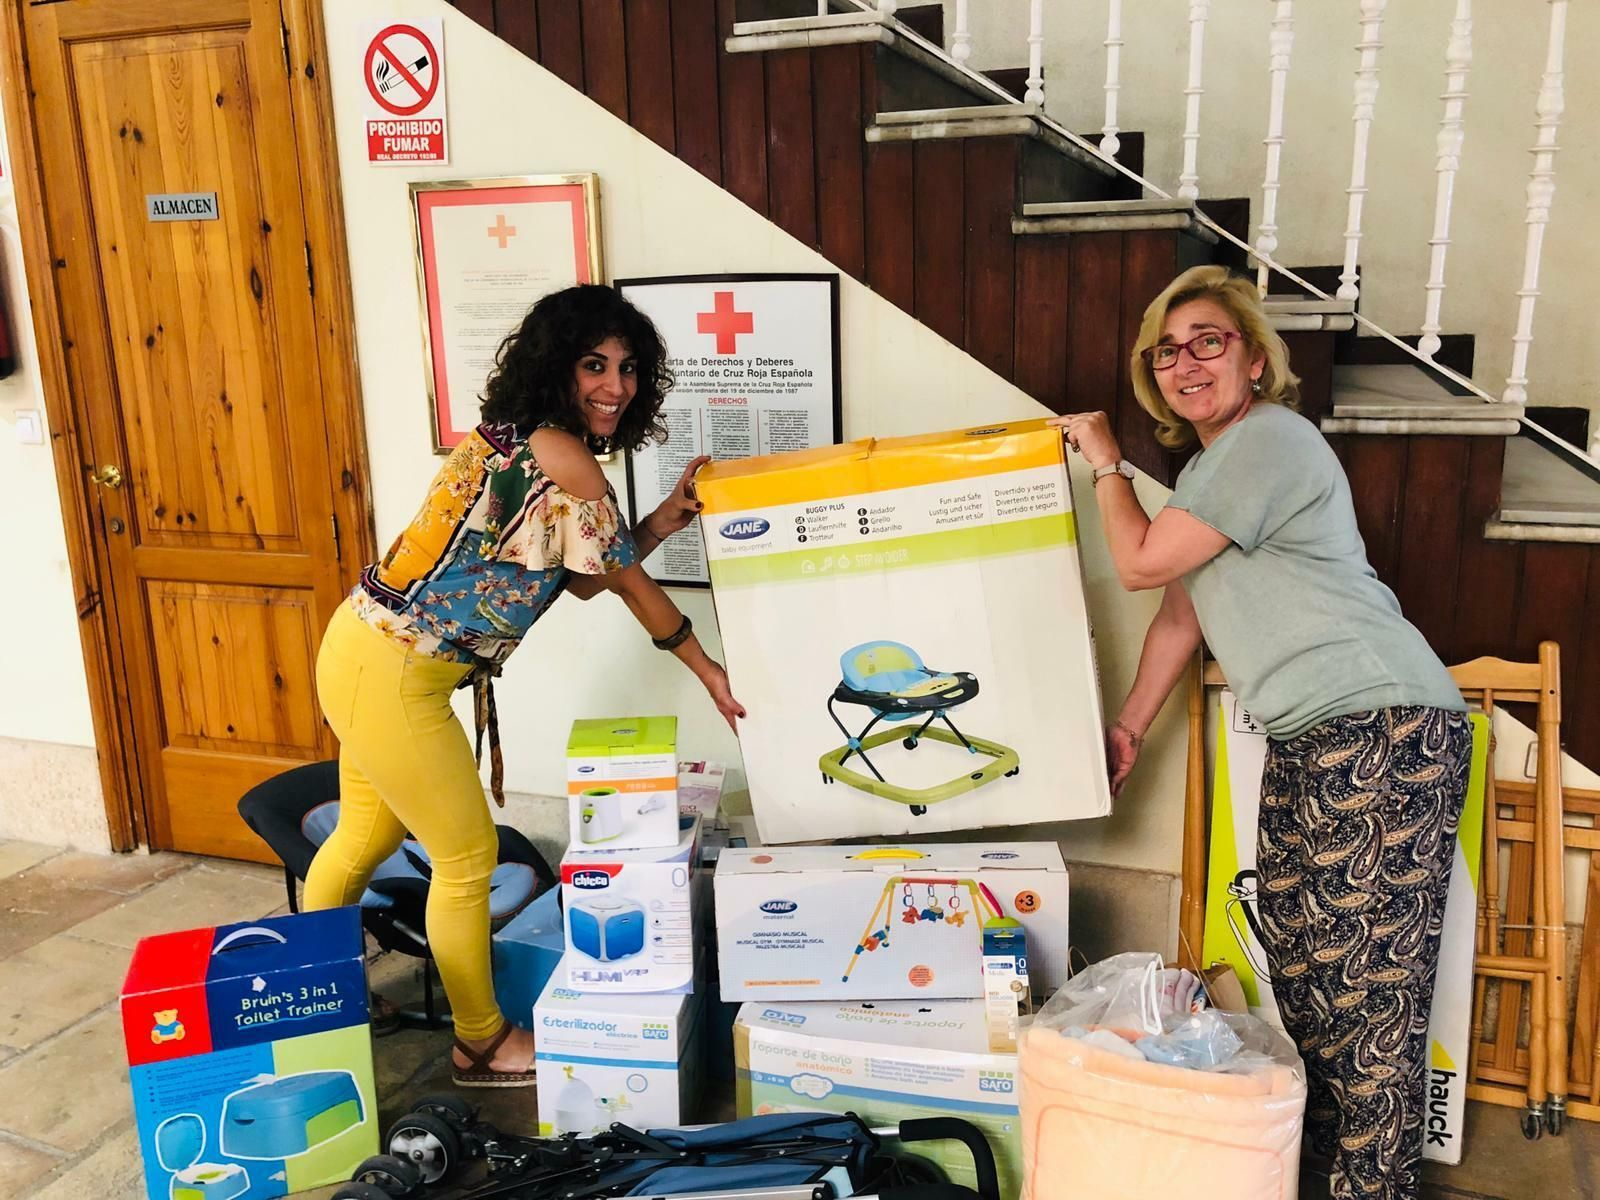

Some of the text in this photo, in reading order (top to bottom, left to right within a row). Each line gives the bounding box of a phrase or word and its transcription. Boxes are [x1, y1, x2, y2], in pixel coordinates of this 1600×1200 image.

[369, 120, 441, 136] PROHIBIDO
[384, 137, 430, 151] FUMAR
[153, 199, 212, 214] ALMACEN
[666, 357, 794, 368] arta de Derechos y Deberes
[708, 369, 720, 377] de
[723, 369, 744, 378] Cruz
[747, 369, 768, 379] Roja
[771, 369, 813, 380] Española
[717, 381, 741, 389] Suprema
[708, 397, 748, 405] DERECHOS
[995, 488, 1025, 497] Divertido
[1032, 482, 1055, 492] seguro
[1036, 491, 1056, 500] sicuro
[940, 493, 981, 505] Fun and Safe
[805, 503, 845, 515] BUGGY PLUS
[870, 505, 896, 514] Andador
[929, 503, 982, 517] Lustig und sicher
[997, 506, 1028, 516] Divertido
[1035, 501, 1058, 511] seguro
[807, 516, 828, 524] Walker
[936, 515, 964, 525] Amusant
[966, 513, 973, 521] et
[872, 523, 902, 534] Andarilho
[721, 542, 773, 554] baby equipment
[574, 873, 608, 886] chicco
[672, 867, 686, 888] 0
[1019, 894, 1034, 906] +3
[571, 971, 622, 982] HUMI
[242, 983, 338, 1010] Bruin's 3 in 1
[234, 999, 344, 1026] Toilet Trainer
[543, 1016, 618, 1032] Esterilizador
[879, 1017, 898, 1025] de
[904, 1020, 966, 1029] Soporte
[752, 1040, 852, 1067] Soporte de baño
[1427, 1069, 1457, 1147] hauck
